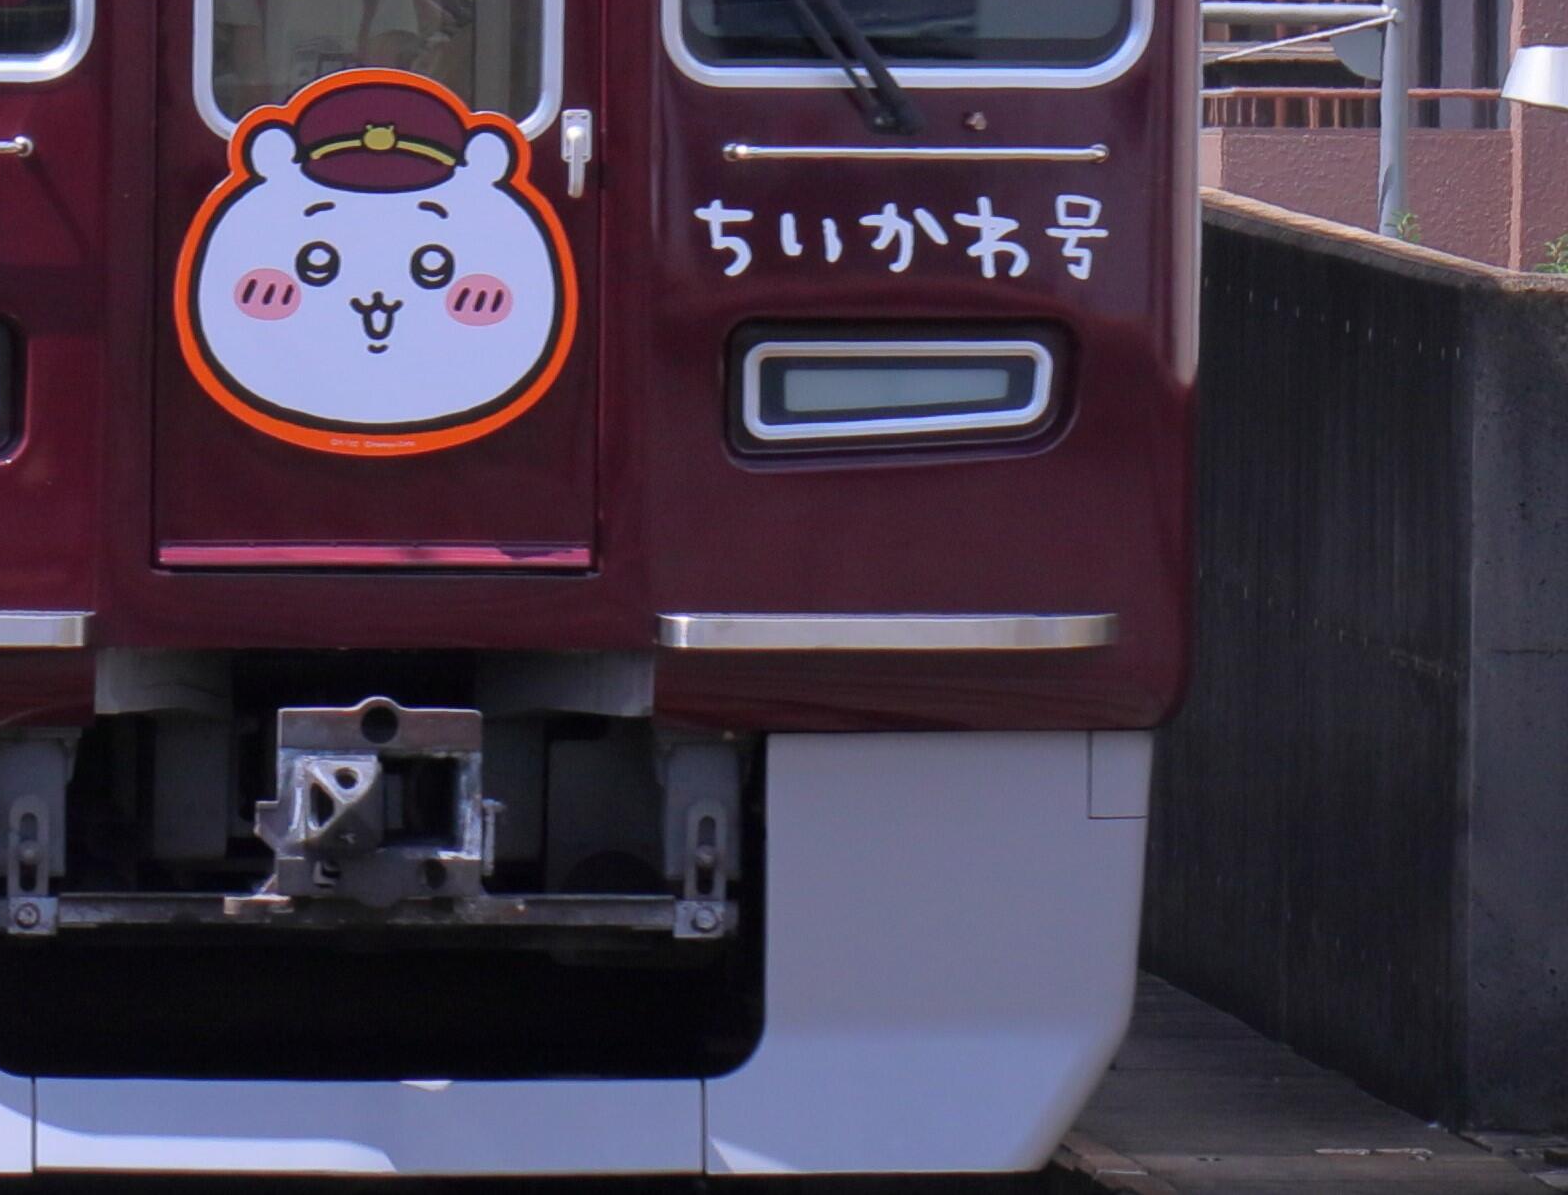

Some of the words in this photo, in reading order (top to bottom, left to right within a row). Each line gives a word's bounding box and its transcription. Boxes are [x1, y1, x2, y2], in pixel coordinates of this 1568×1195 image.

[693, 193, 1110, 281] ちいかわ号
